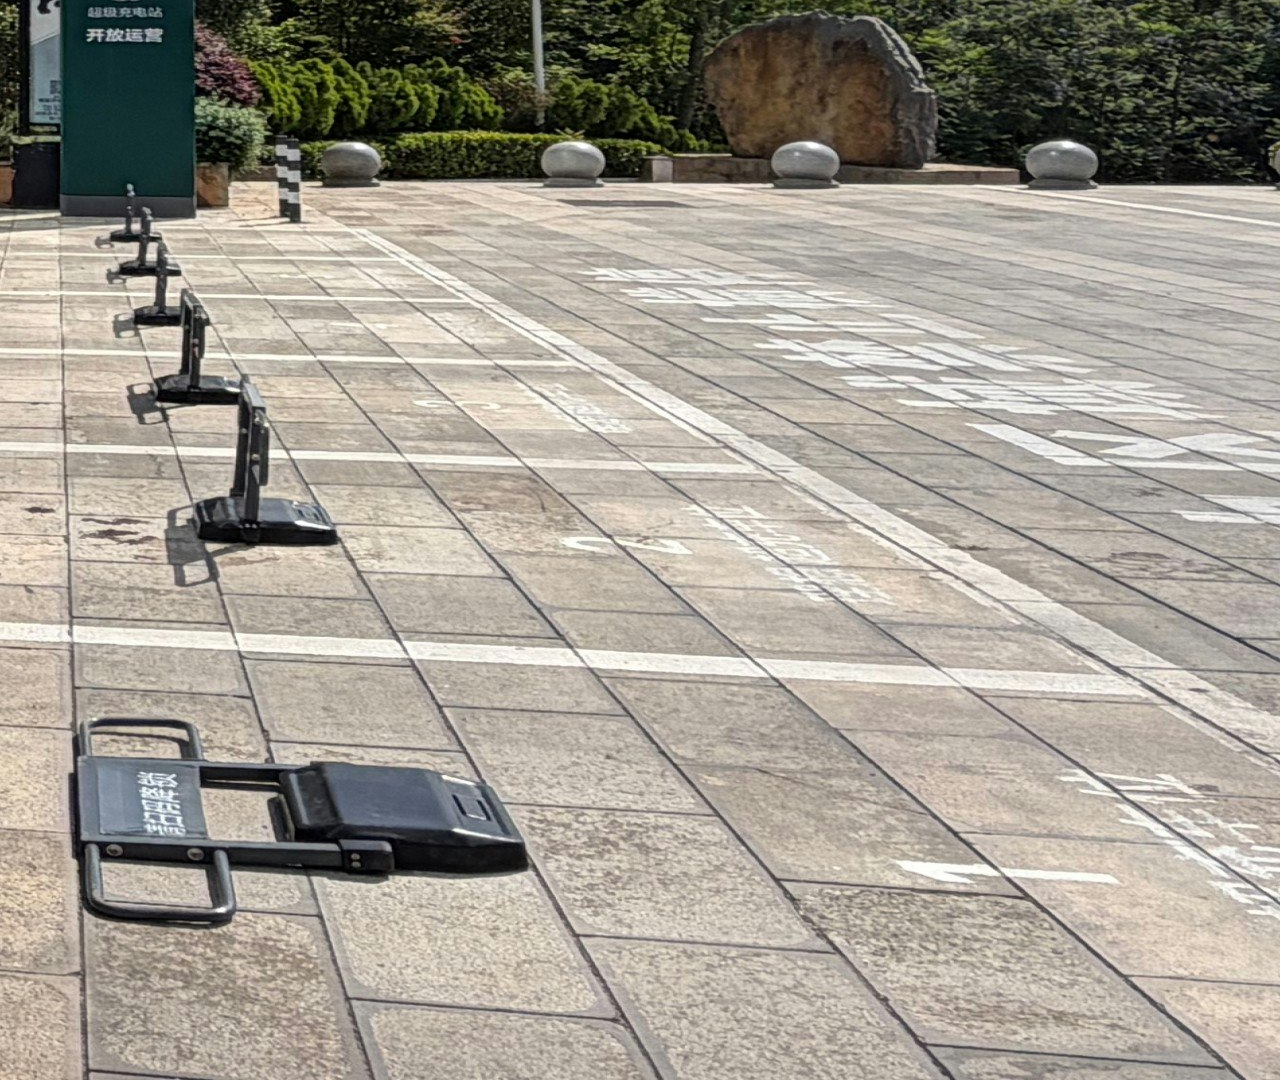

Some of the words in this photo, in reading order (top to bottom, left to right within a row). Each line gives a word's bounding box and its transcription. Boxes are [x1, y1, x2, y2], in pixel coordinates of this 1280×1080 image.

[87, 6, 163, 18] 超级充电站
[85, 27, 164, 43] 开放运营
[560, 535, 694, 556] 2
